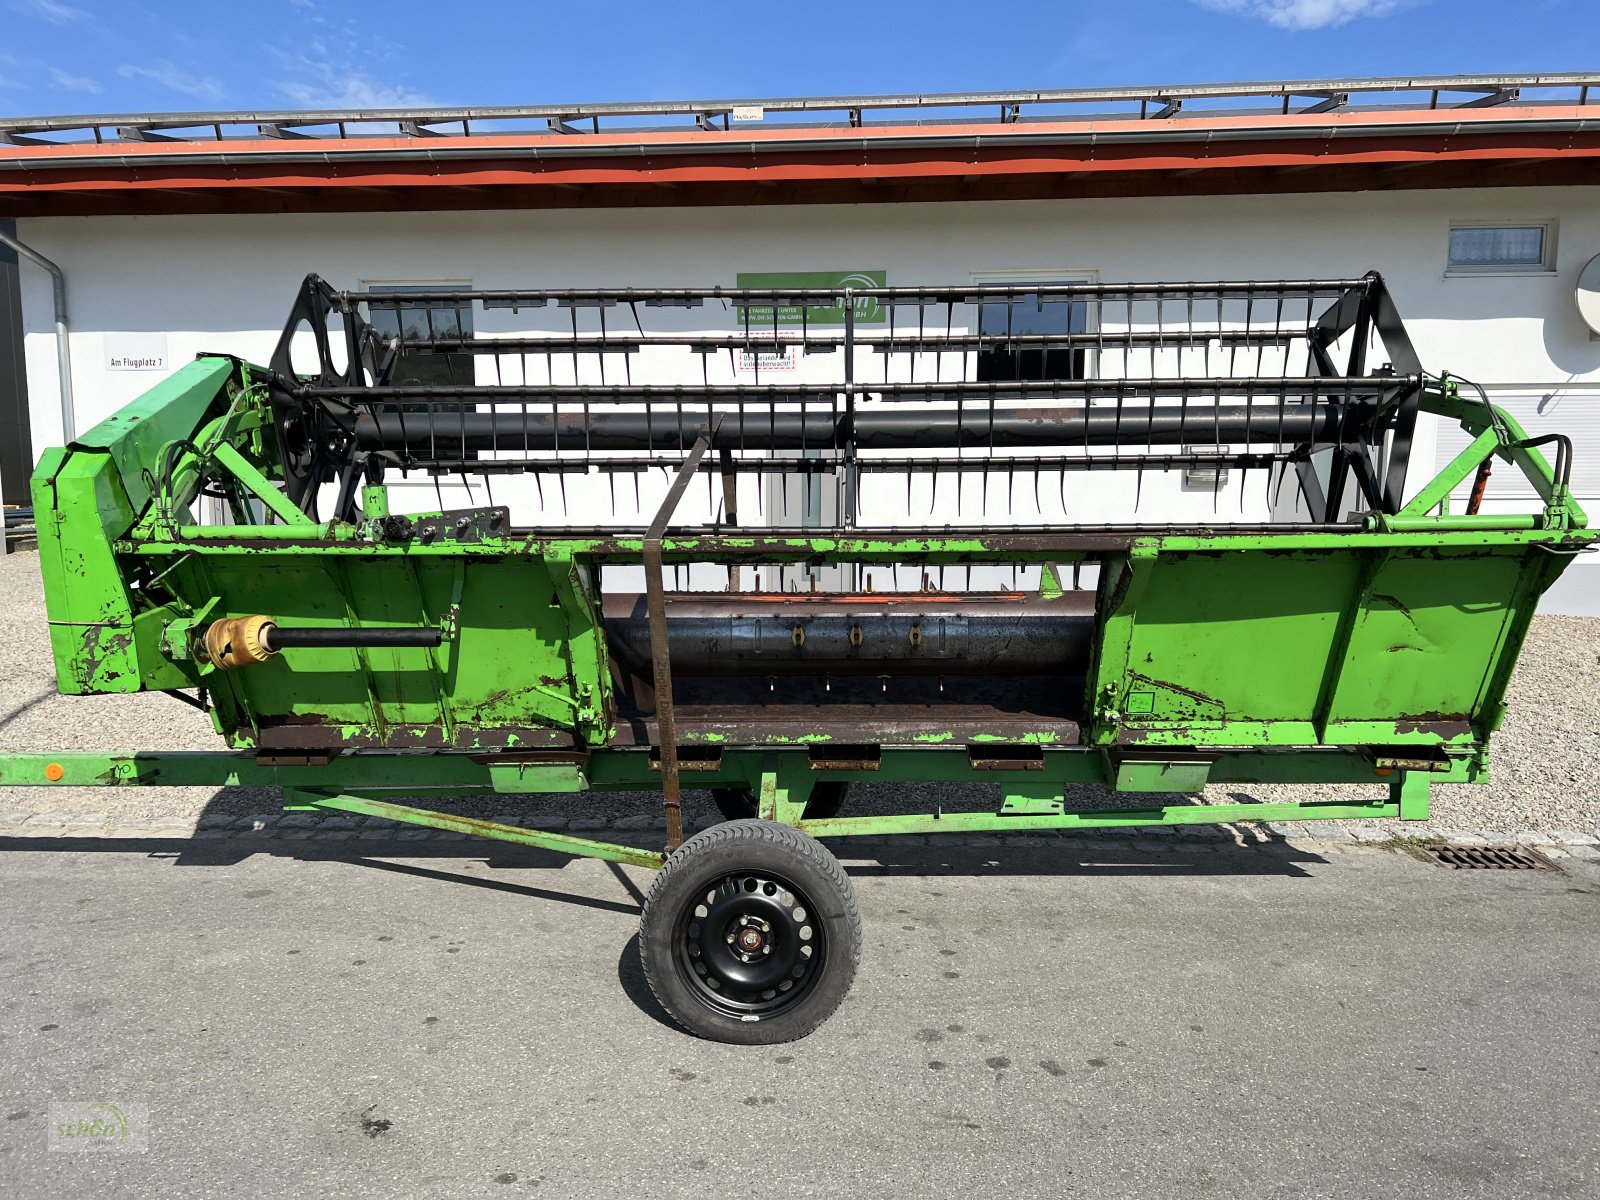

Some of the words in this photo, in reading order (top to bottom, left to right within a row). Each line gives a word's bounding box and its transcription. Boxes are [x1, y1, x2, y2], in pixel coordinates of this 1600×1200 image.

[110, 358, 122, 366] Am
[123, 358, 156, 368] Flugplatz
[158, 358, 163, 366] 7
